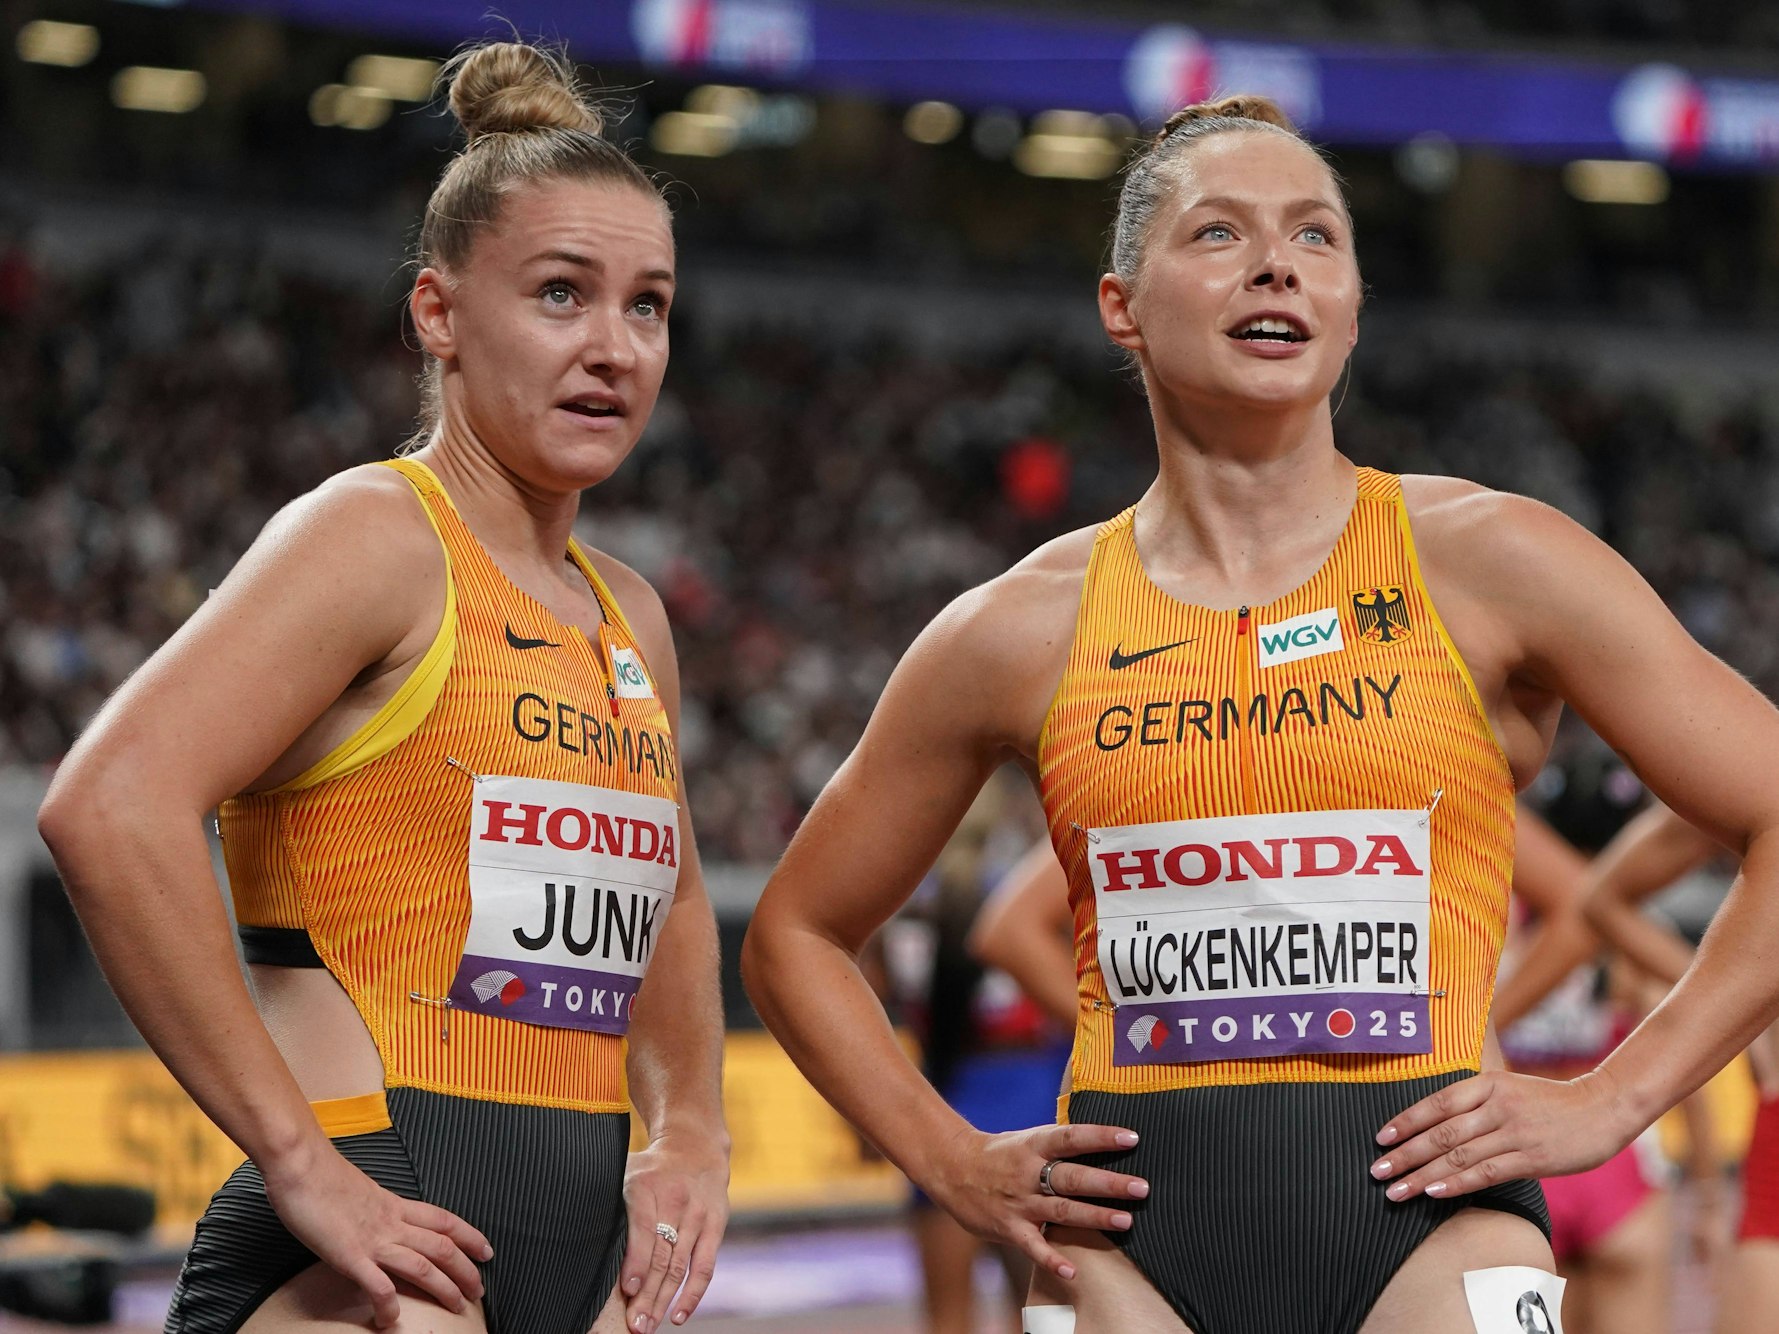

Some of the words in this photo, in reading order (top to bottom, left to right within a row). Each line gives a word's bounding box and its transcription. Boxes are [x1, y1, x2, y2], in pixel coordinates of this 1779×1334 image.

[1261, 618, 1338, 656] WGV
[1095, 674, 1402, 752] GERMANY
[479, 800, 677, 869] HONDA
[1096, 835, 1424, 892] HONDA
[512, 882, 661, 964] JUNK
[1110, 921, 1418, 997] LÜCKENKEMPER
